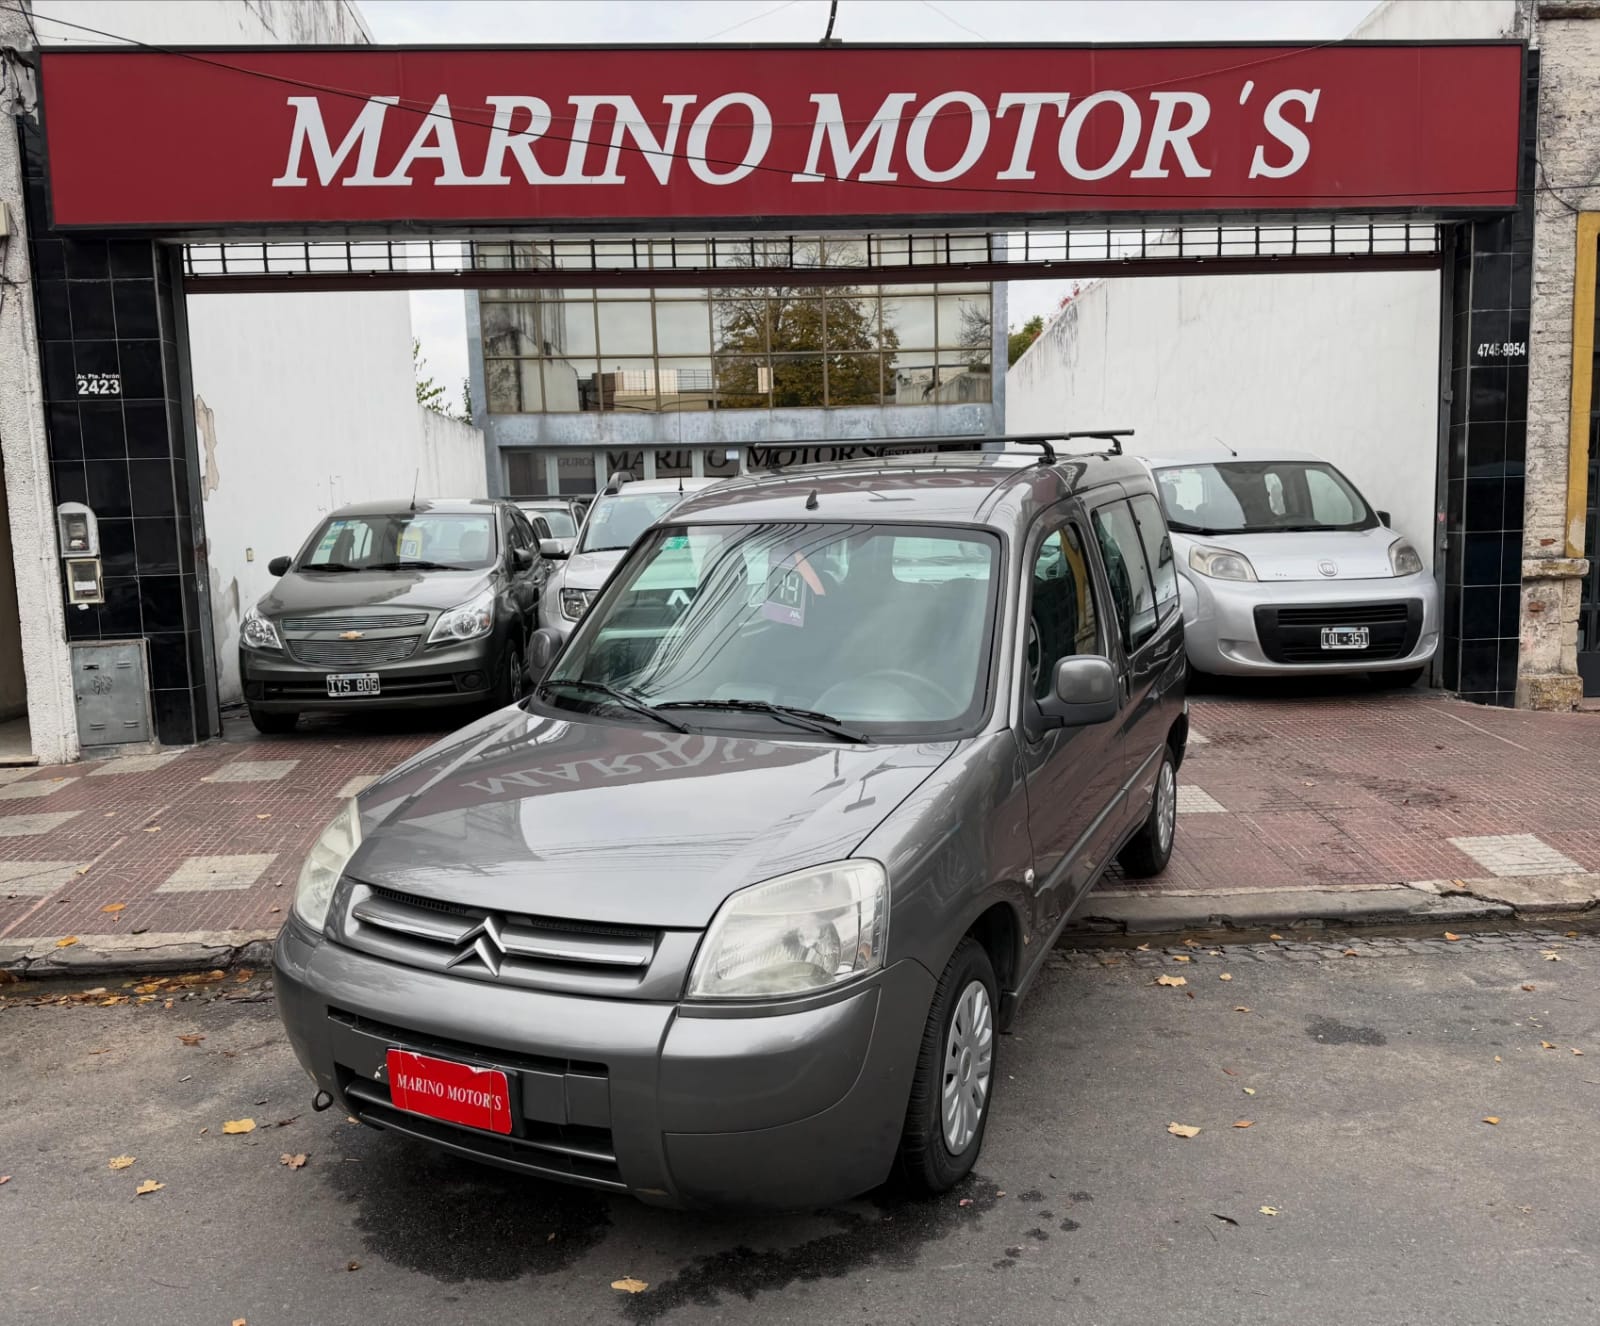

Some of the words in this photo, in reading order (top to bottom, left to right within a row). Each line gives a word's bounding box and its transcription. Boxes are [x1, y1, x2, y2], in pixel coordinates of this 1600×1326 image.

[272, 92, 773, 187] MARINO
[78, 380, 120, 394] 2423
[1347, 632, 1367, 645] 351
[329, 679, 350, 693] IYS
[357, 678, 378, 691] 806
[397, 1073, 444, 1098] MARINO
